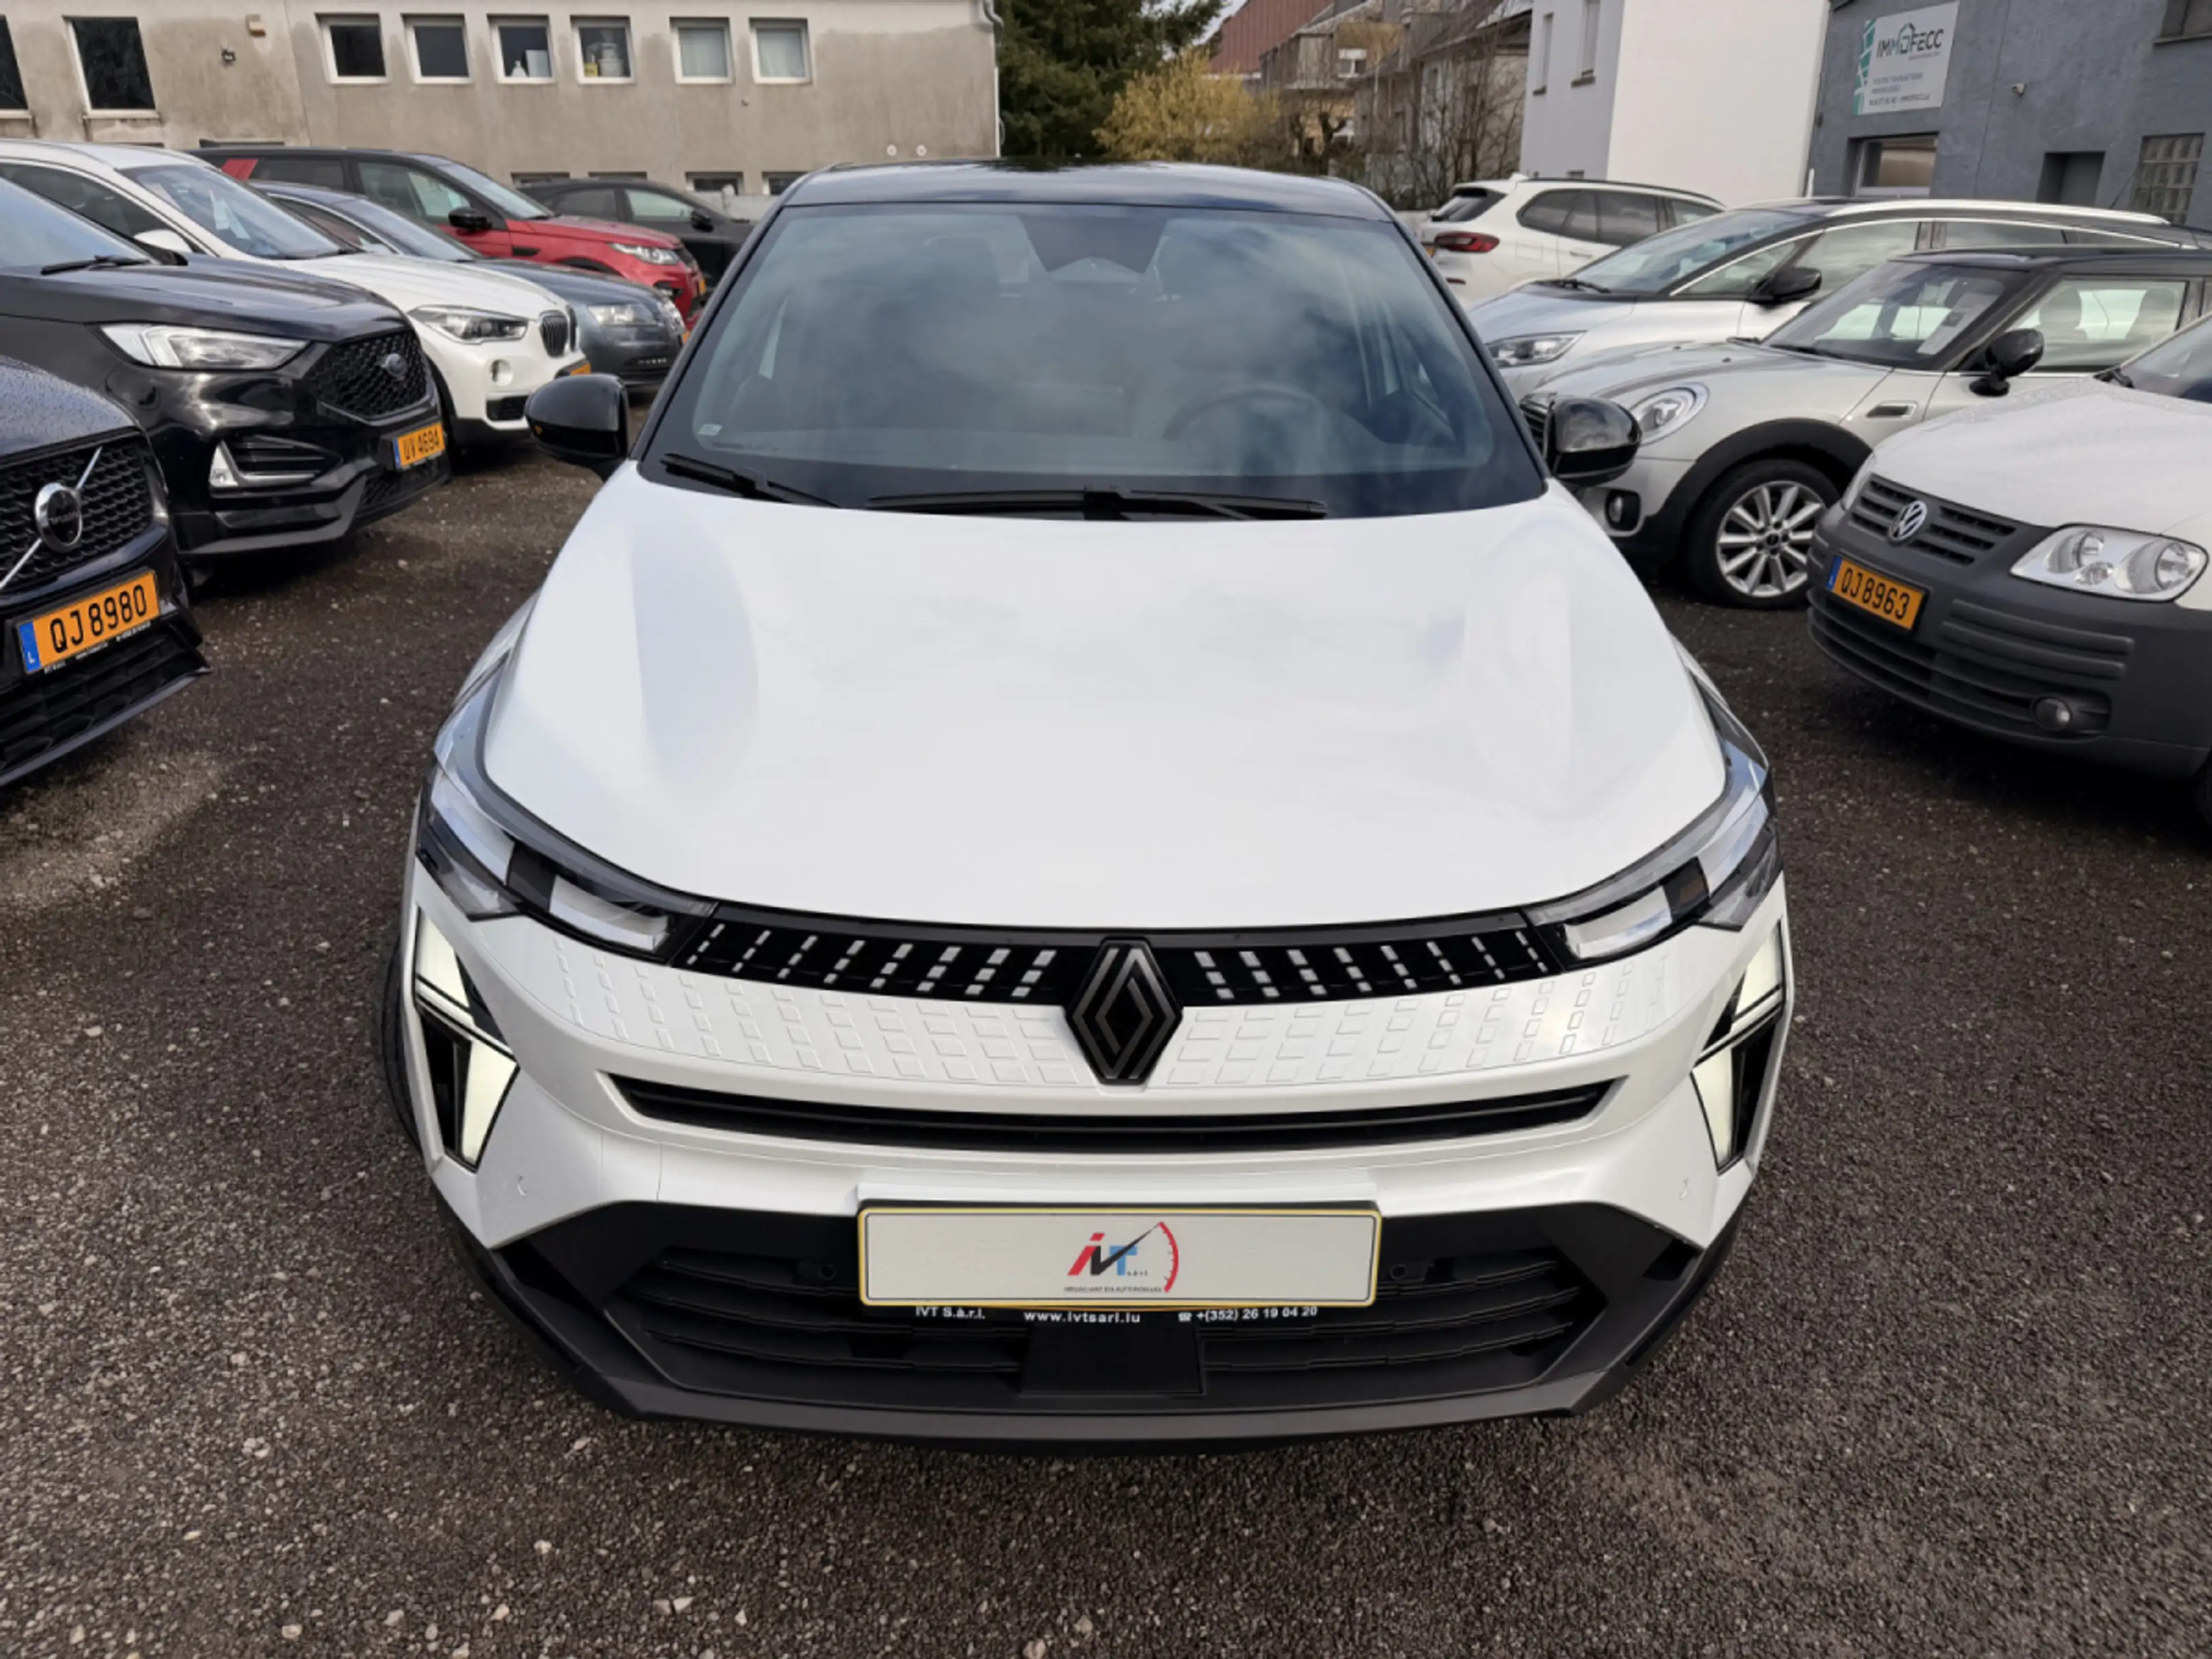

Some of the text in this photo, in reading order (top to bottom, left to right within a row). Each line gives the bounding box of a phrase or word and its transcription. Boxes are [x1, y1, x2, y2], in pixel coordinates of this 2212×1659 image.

[915, 1305, 938, 1317] IVT
[1196, 1305, 1318, 1322] +(352) 26 19 04 20
